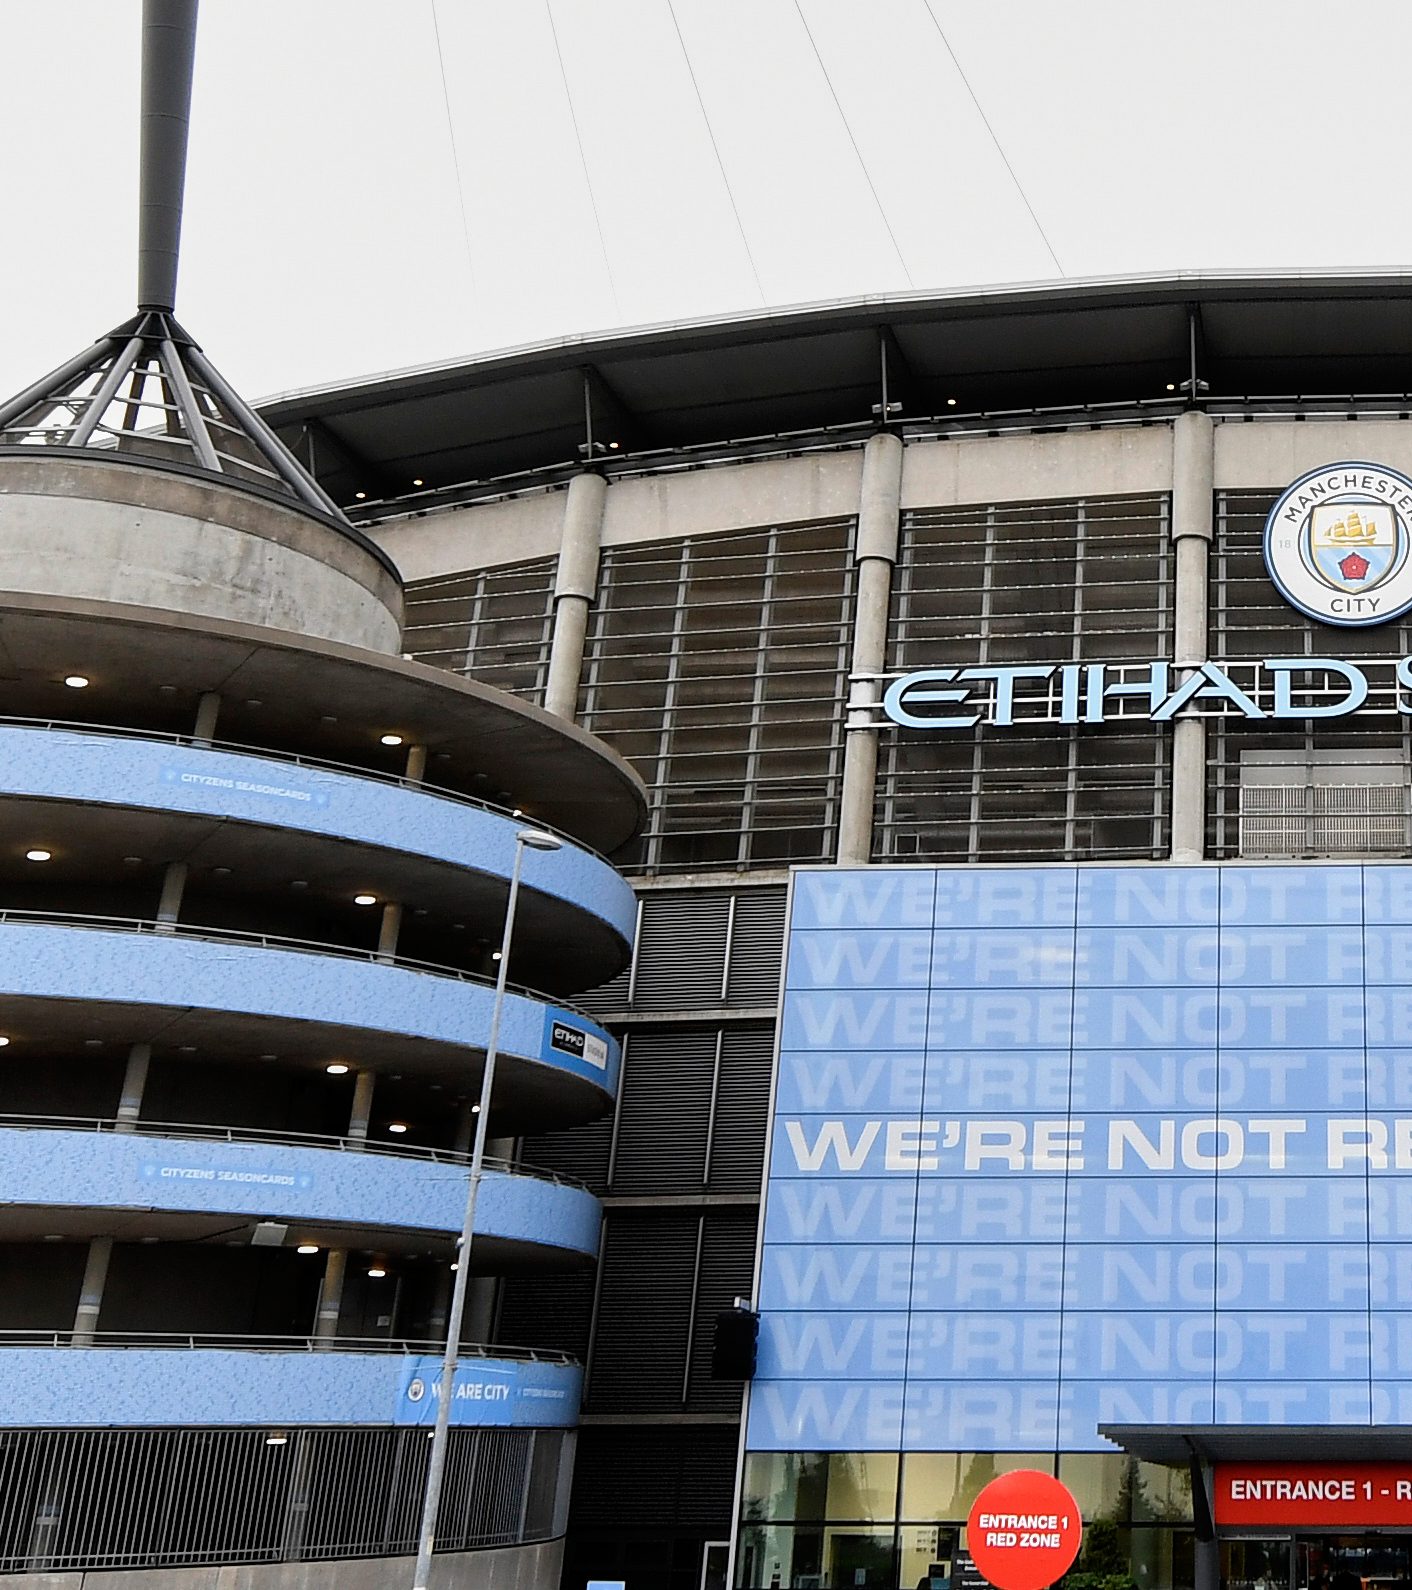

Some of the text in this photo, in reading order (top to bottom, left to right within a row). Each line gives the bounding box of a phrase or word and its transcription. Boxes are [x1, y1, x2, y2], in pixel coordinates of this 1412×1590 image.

[1330, 598, 1381, 613] CITY
[883, 658, 1369, 730] ETIHAD
[181, 773, 234, 788] CITYZENS
[802, 876, 1090, 923] WE'RE
[1114, 874, 1305, 922] NOT
[800, 935, 1088, 985] WE'RE
[1112, 933, 1305, 981] NOT
[796, 995, 1087, 1046] WE'RE
[1111, 995, 1305, 1043] NOT
[791, 1057, 1086, 1110] WE'RE
[1110, 1056, 1306, 1106] NOT
[785, 1120, 1085, 1172] WE'RE
[1107, 1120, 1306, 1170] NOT
[161, 1167, 295, 1186] CITYZENS SEASONCARDS
[777, 1185, 1082, 1237] WE'RE
[1105, 1185, 1306, 1236] NOT
[772, 1250, 1078, 1303] WE'RE
[1103, 1250, 1306, 1302] NOT
[767, 1317, 1076, 1372] WE'RE
[1101, 1317, 1307, 1372] NOT
[432, 1383, 455, 1398] W
[456, 1383, 482, 1399] ARE
[485, 1383, 510, 1400] CITY
[761, 1386, 1074, 1443] WE'RE
[1100, 1386, 1307, 1424] NOT
[1231, 1480, 1356, 1500] ENTRANCE
[1363, 1480, 1373, 1499] 1
[979, 1514, 1069, 1530] ENTRANCE 1
[986, 1533, 1061, 1548] RED ZONE
